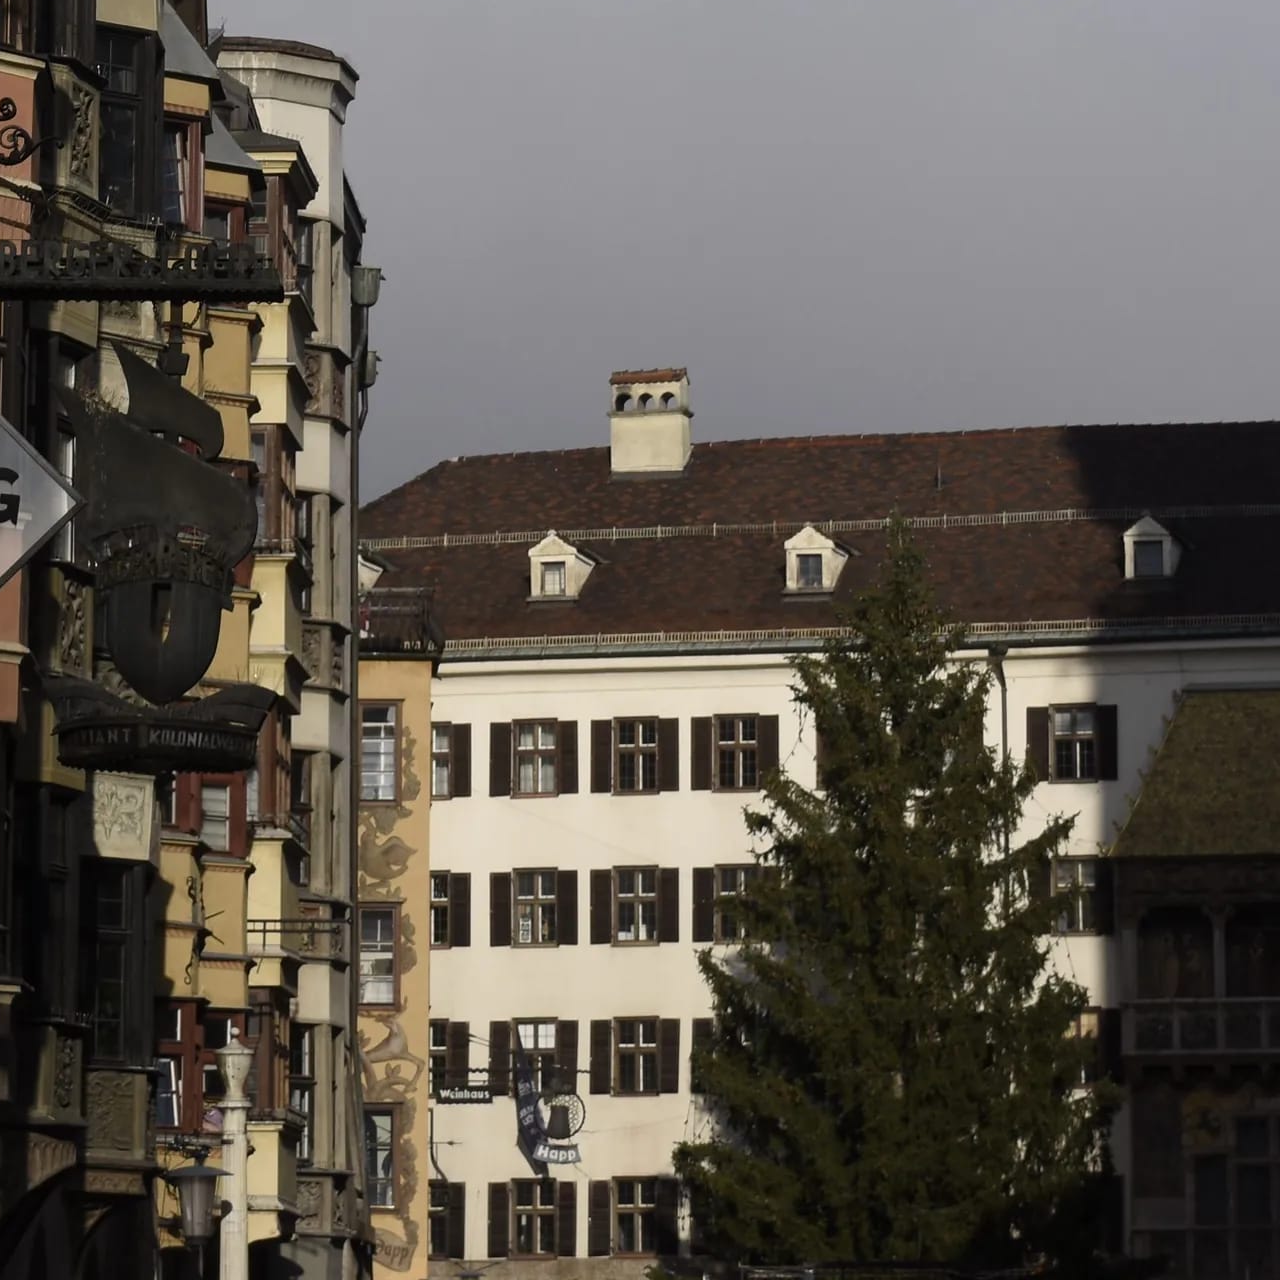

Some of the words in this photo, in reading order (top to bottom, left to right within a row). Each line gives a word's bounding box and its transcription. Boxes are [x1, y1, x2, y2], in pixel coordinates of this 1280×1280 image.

[69, 728, 132, 747] VIANT
[439, 1086, 490, 1100] Weinhaus
[536, 1145, 577, 1162] Happ
